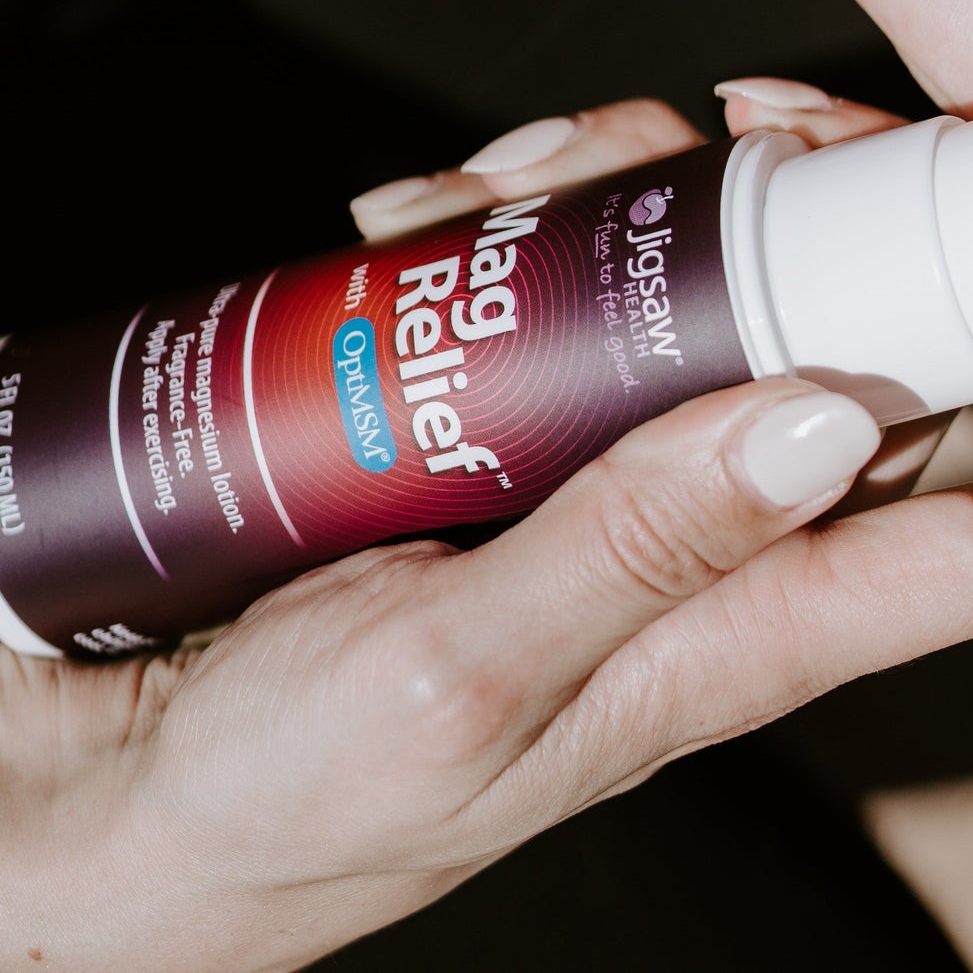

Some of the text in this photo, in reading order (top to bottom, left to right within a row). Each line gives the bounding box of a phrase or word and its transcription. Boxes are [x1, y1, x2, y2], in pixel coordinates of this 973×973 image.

[343, 263, 369, 310] with
[451, 194, 551, 341] Mag
[595, 193, 640, 394] It's fun to feel good.
[623, 280, 650, 358] HEALTH
[141, 319, 176, 516] Apply after exercising.
[165, 332, 196, 479] Fragrance-Free.
[190, 357, 223, 472] magnesium
[211, 472, 245, 535] lotion.
